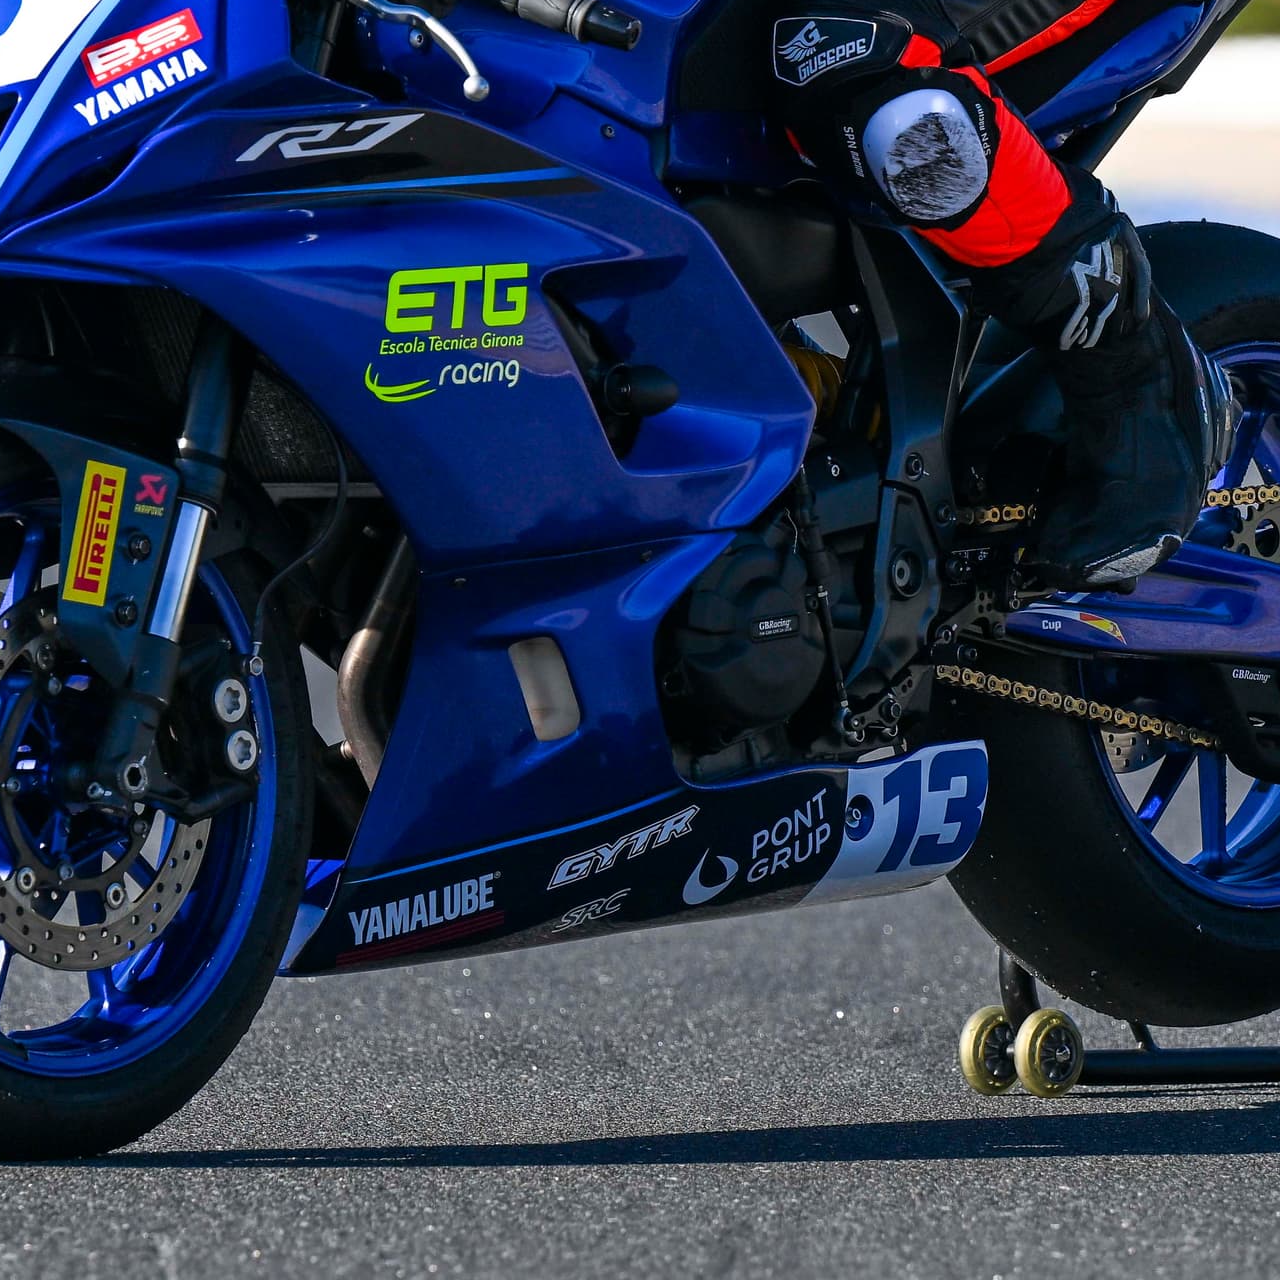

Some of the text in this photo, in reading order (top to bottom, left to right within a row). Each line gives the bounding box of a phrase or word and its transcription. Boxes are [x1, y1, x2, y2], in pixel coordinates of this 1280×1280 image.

[87, 17, 186, 76] BS
[73, 49, 208, 126] YAMAHA
[235, 113, 425, 162] R7
[843, 126, 857, 149] SPN
[385, 263, 528, 333] ETG
[379, 332, 524, 355] Escola Tècnica Girona
[438, 359, 520, 388] racing
[73, 473, 117, 593] PIRELLI
[1042, 619, 1062, 631] Cup
[1232, 668, 1270, 683] GBRacing
[751, 788, 828, 859] PONT
[876, 748, 989, 873] 13
[547, 804, 700, 890] GYTR
[746, 823, 832, 883] GRUP
[349, 872, 496, 946] YAMALUBE
